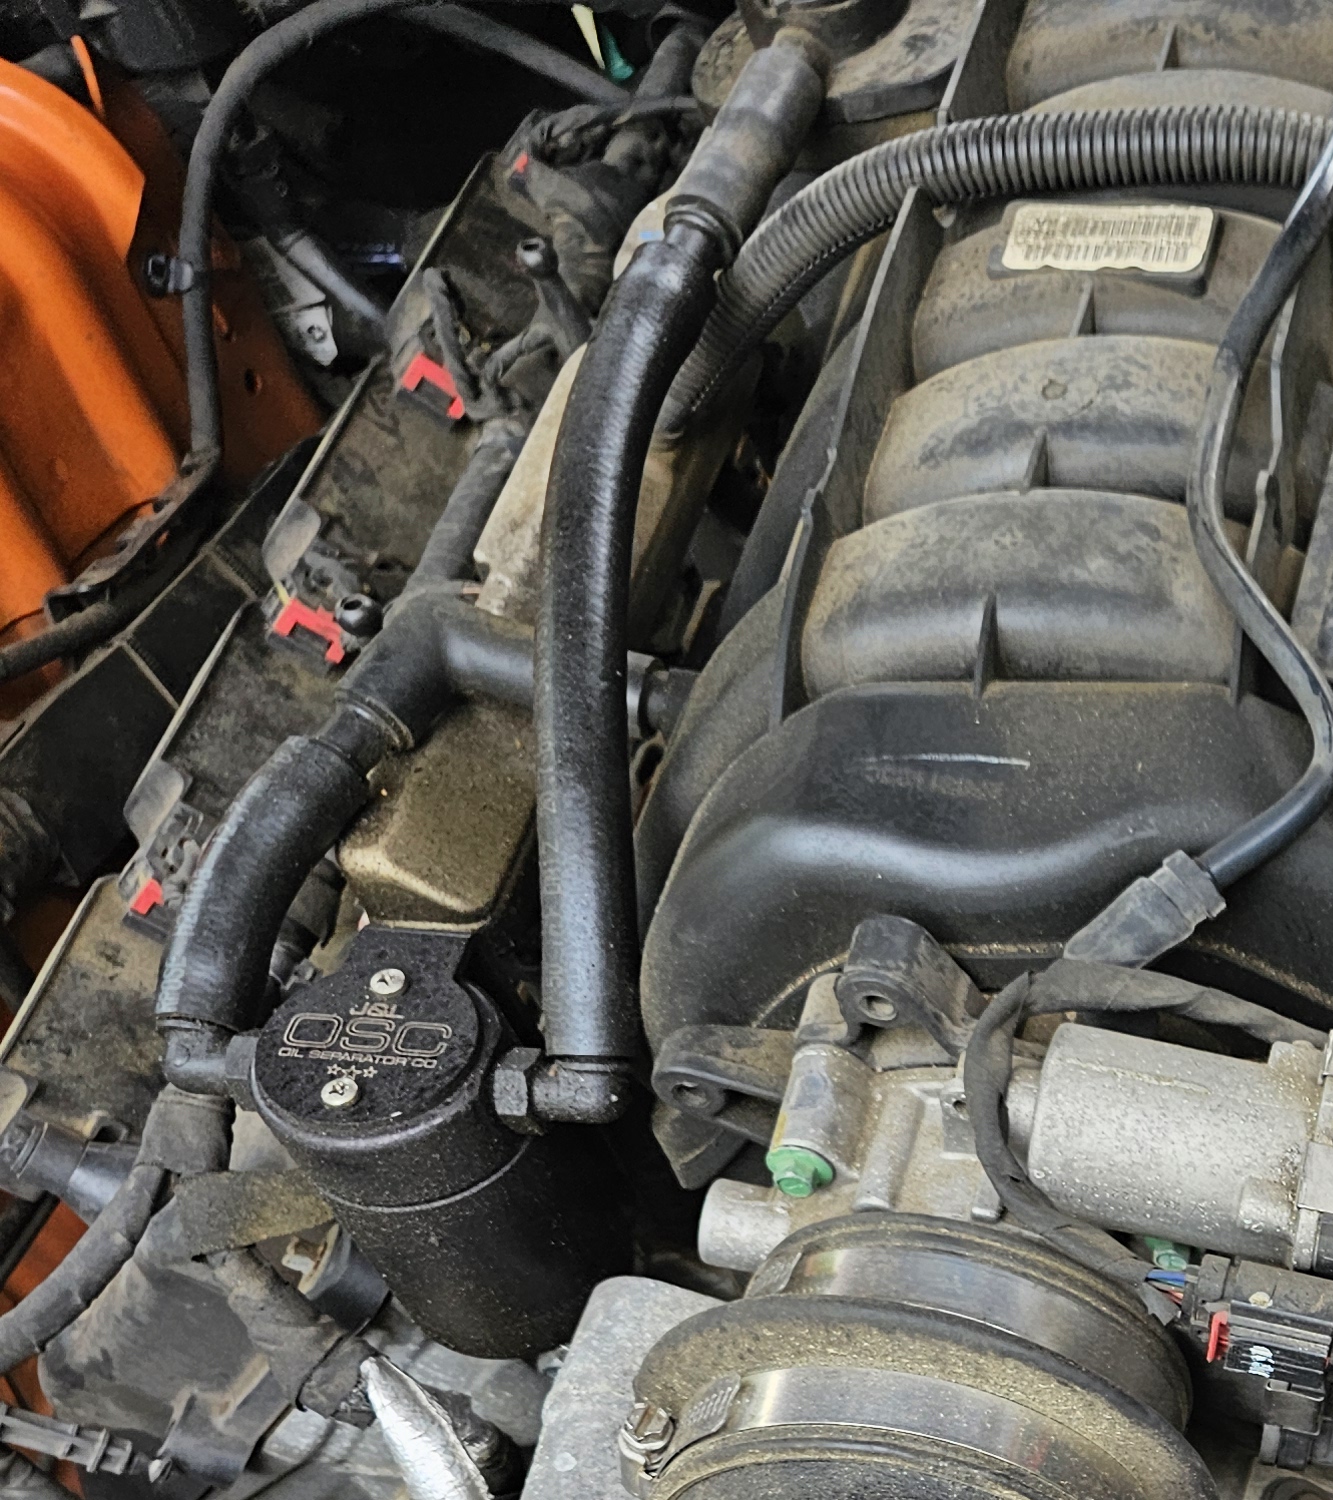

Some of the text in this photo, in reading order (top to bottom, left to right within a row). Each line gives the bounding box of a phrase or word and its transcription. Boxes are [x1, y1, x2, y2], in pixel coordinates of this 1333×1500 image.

[349, 1001, 405, 1020] J&L
[283, 1012, 453, 1058] OSC
[278, 1046, 439, 1069] OIL SEPARATOR CO
